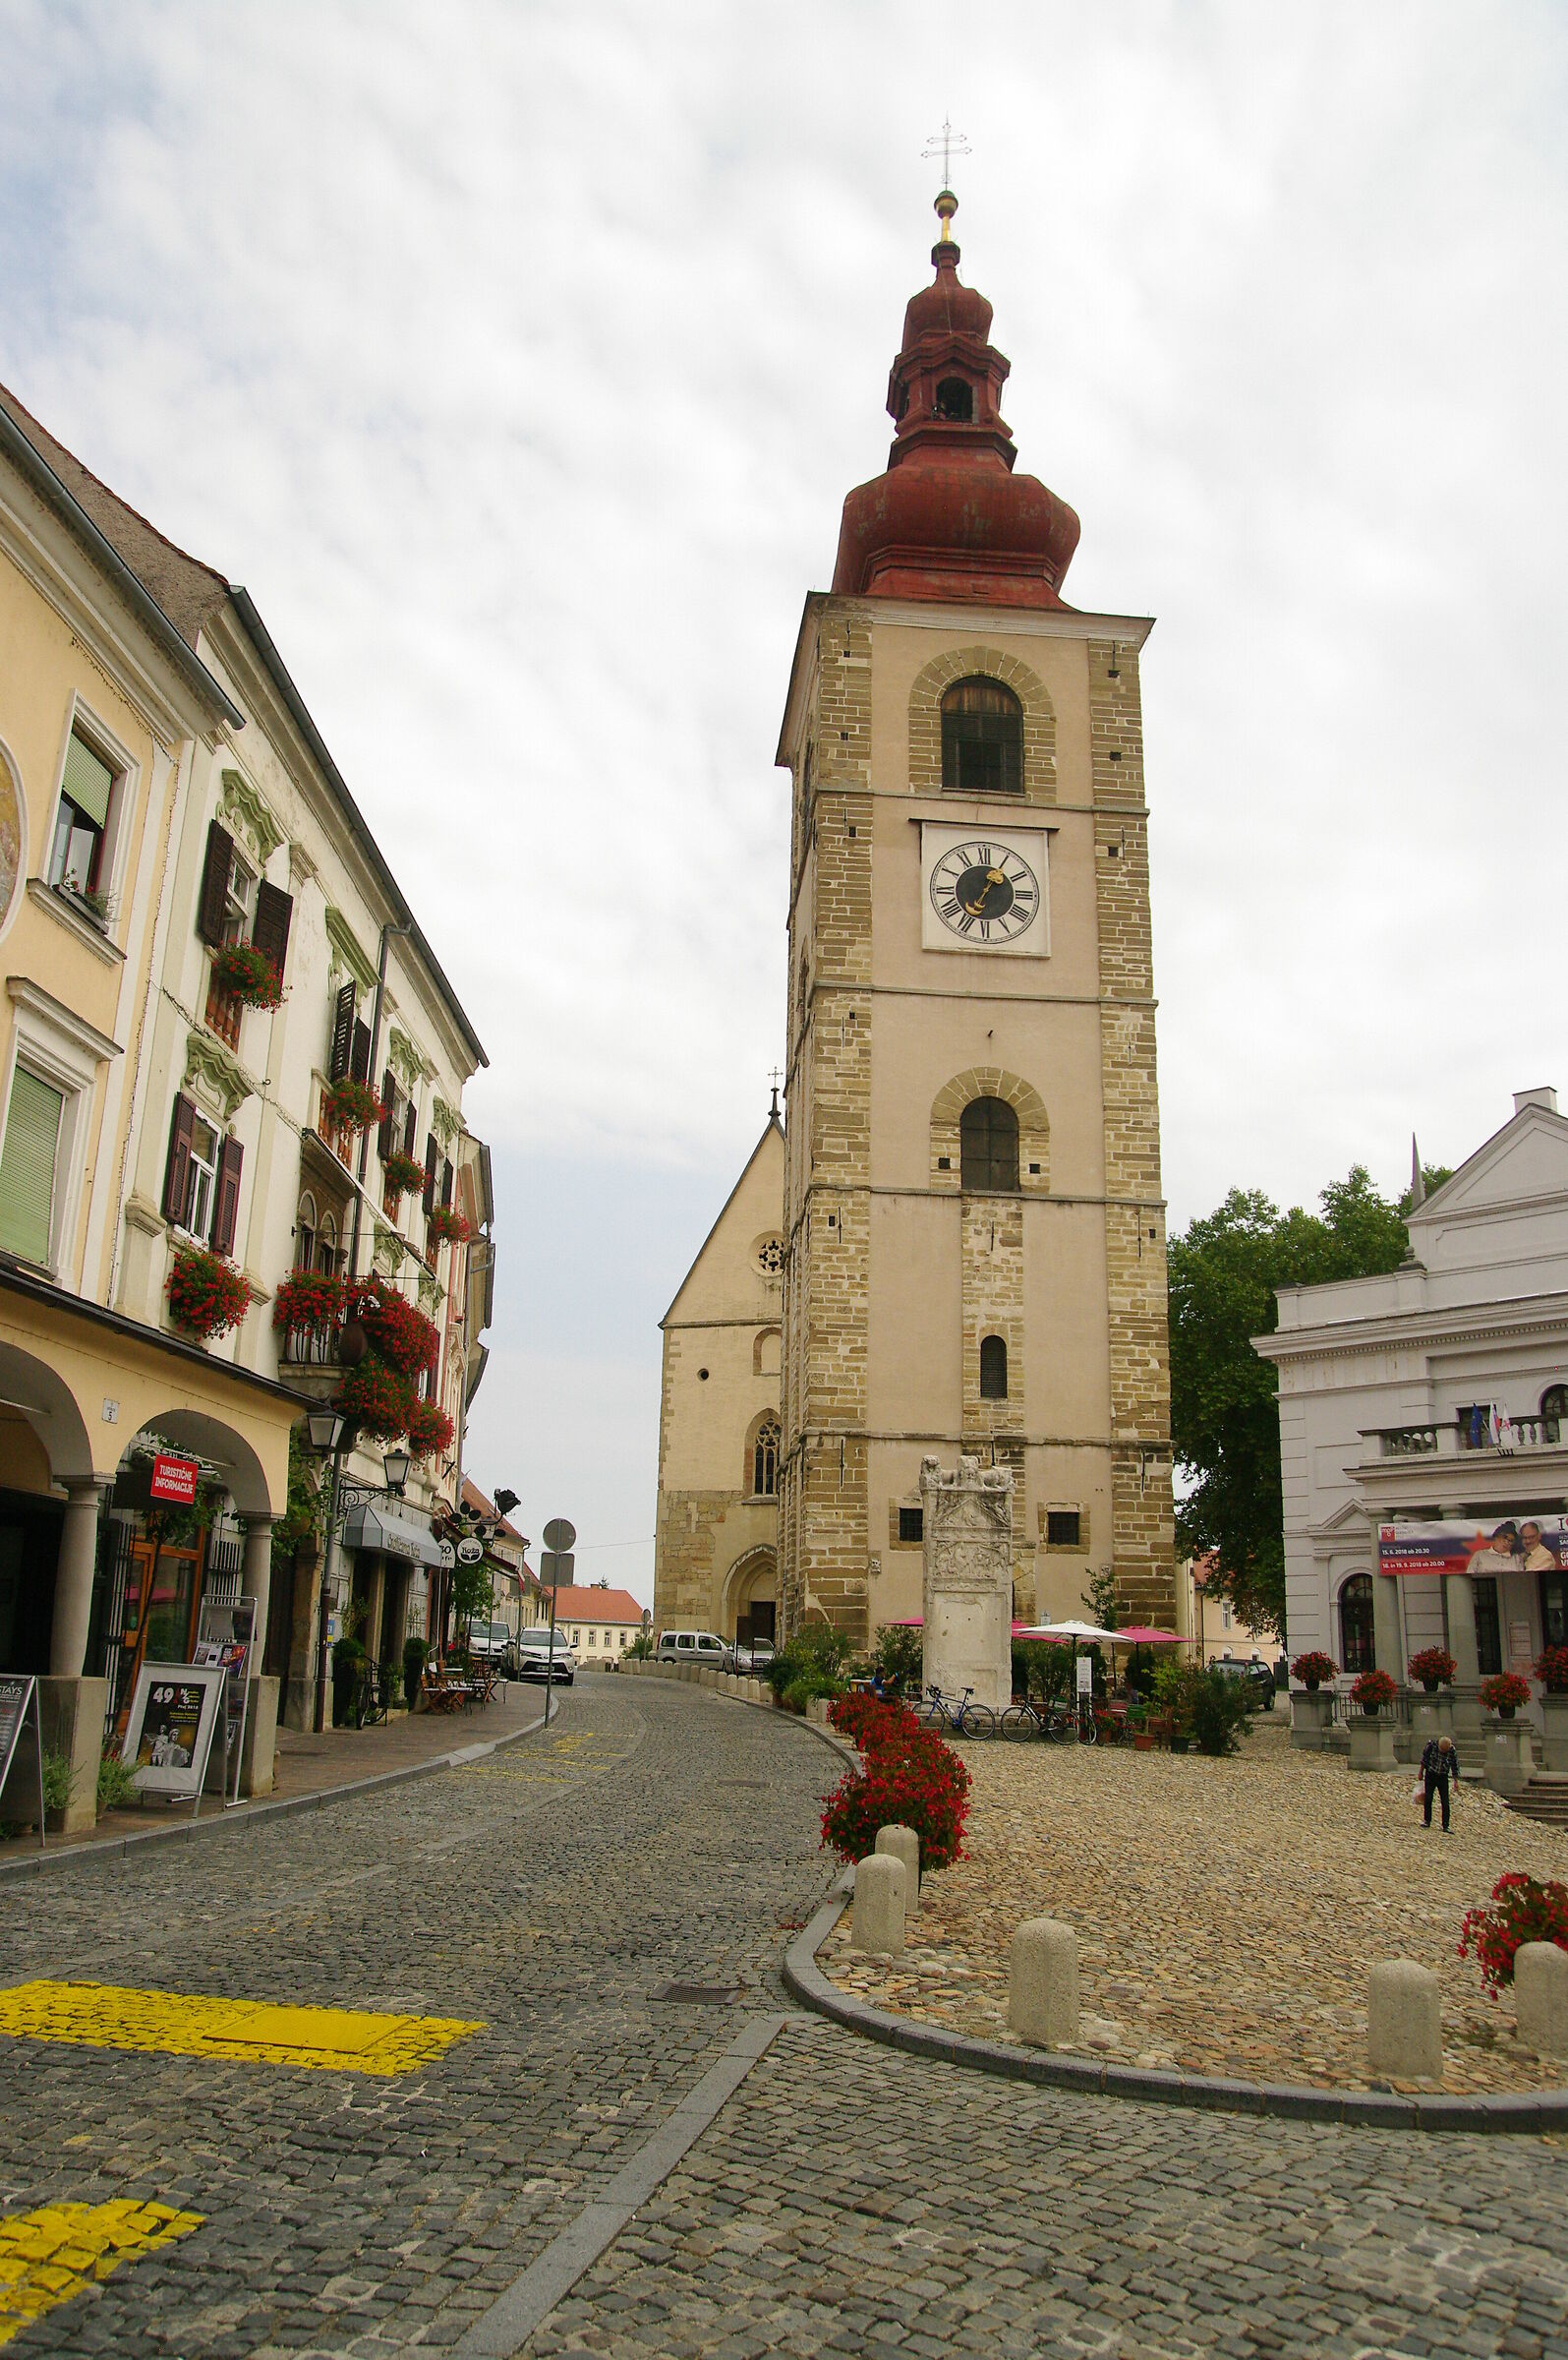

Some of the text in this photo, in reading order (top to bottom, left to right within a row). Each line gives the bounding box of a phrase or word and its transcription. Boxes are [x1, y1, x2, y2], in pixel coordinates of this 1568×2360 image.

[957, 851, 972, 869] XI
[978, 848, 990, 865] XII
[1010, 870, 1027, 883] II
[1015, 890, 1033, 900] III
[980, 920, 990, 939] VI
[998, 917, 1011, 934] V
[108, 1411, 113, 1420] 5
[160, 1465, 193, 1481] TURISTIČNE
[155, 1477, 193, 1494] INFORMACIJE
